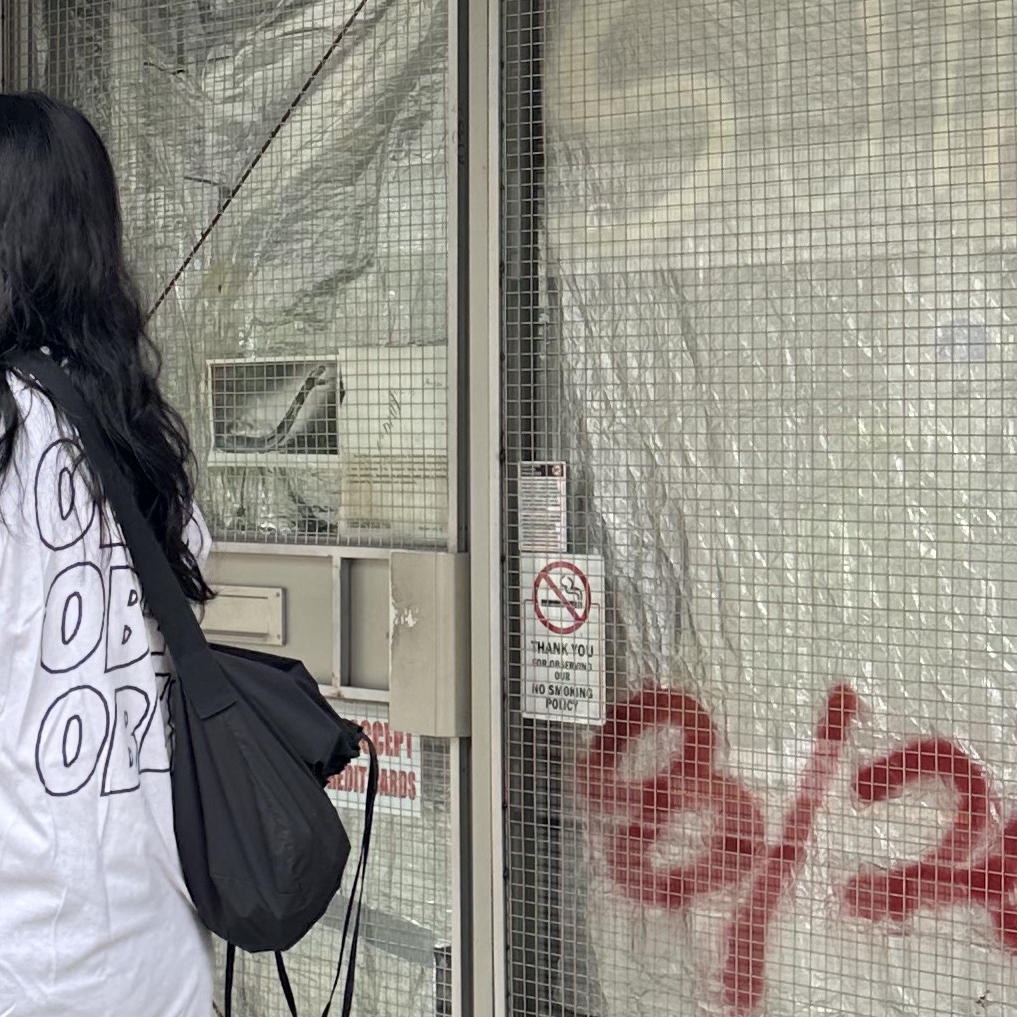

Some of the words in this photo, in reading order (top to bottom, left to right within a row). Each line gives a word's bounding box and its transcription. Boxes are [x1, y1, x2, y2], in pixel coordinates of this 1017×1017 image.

[531, 641, 569, 656] THANK
[571, 643, 594, 658] YOU
[554, 671, 570, 681] OUR
[532, 683, 546, 695] NO
[548, 684, 593, 699] SMOKING
[545, 698, 579, 711] POLICY
[379, 768, 417, 801] ARDS
